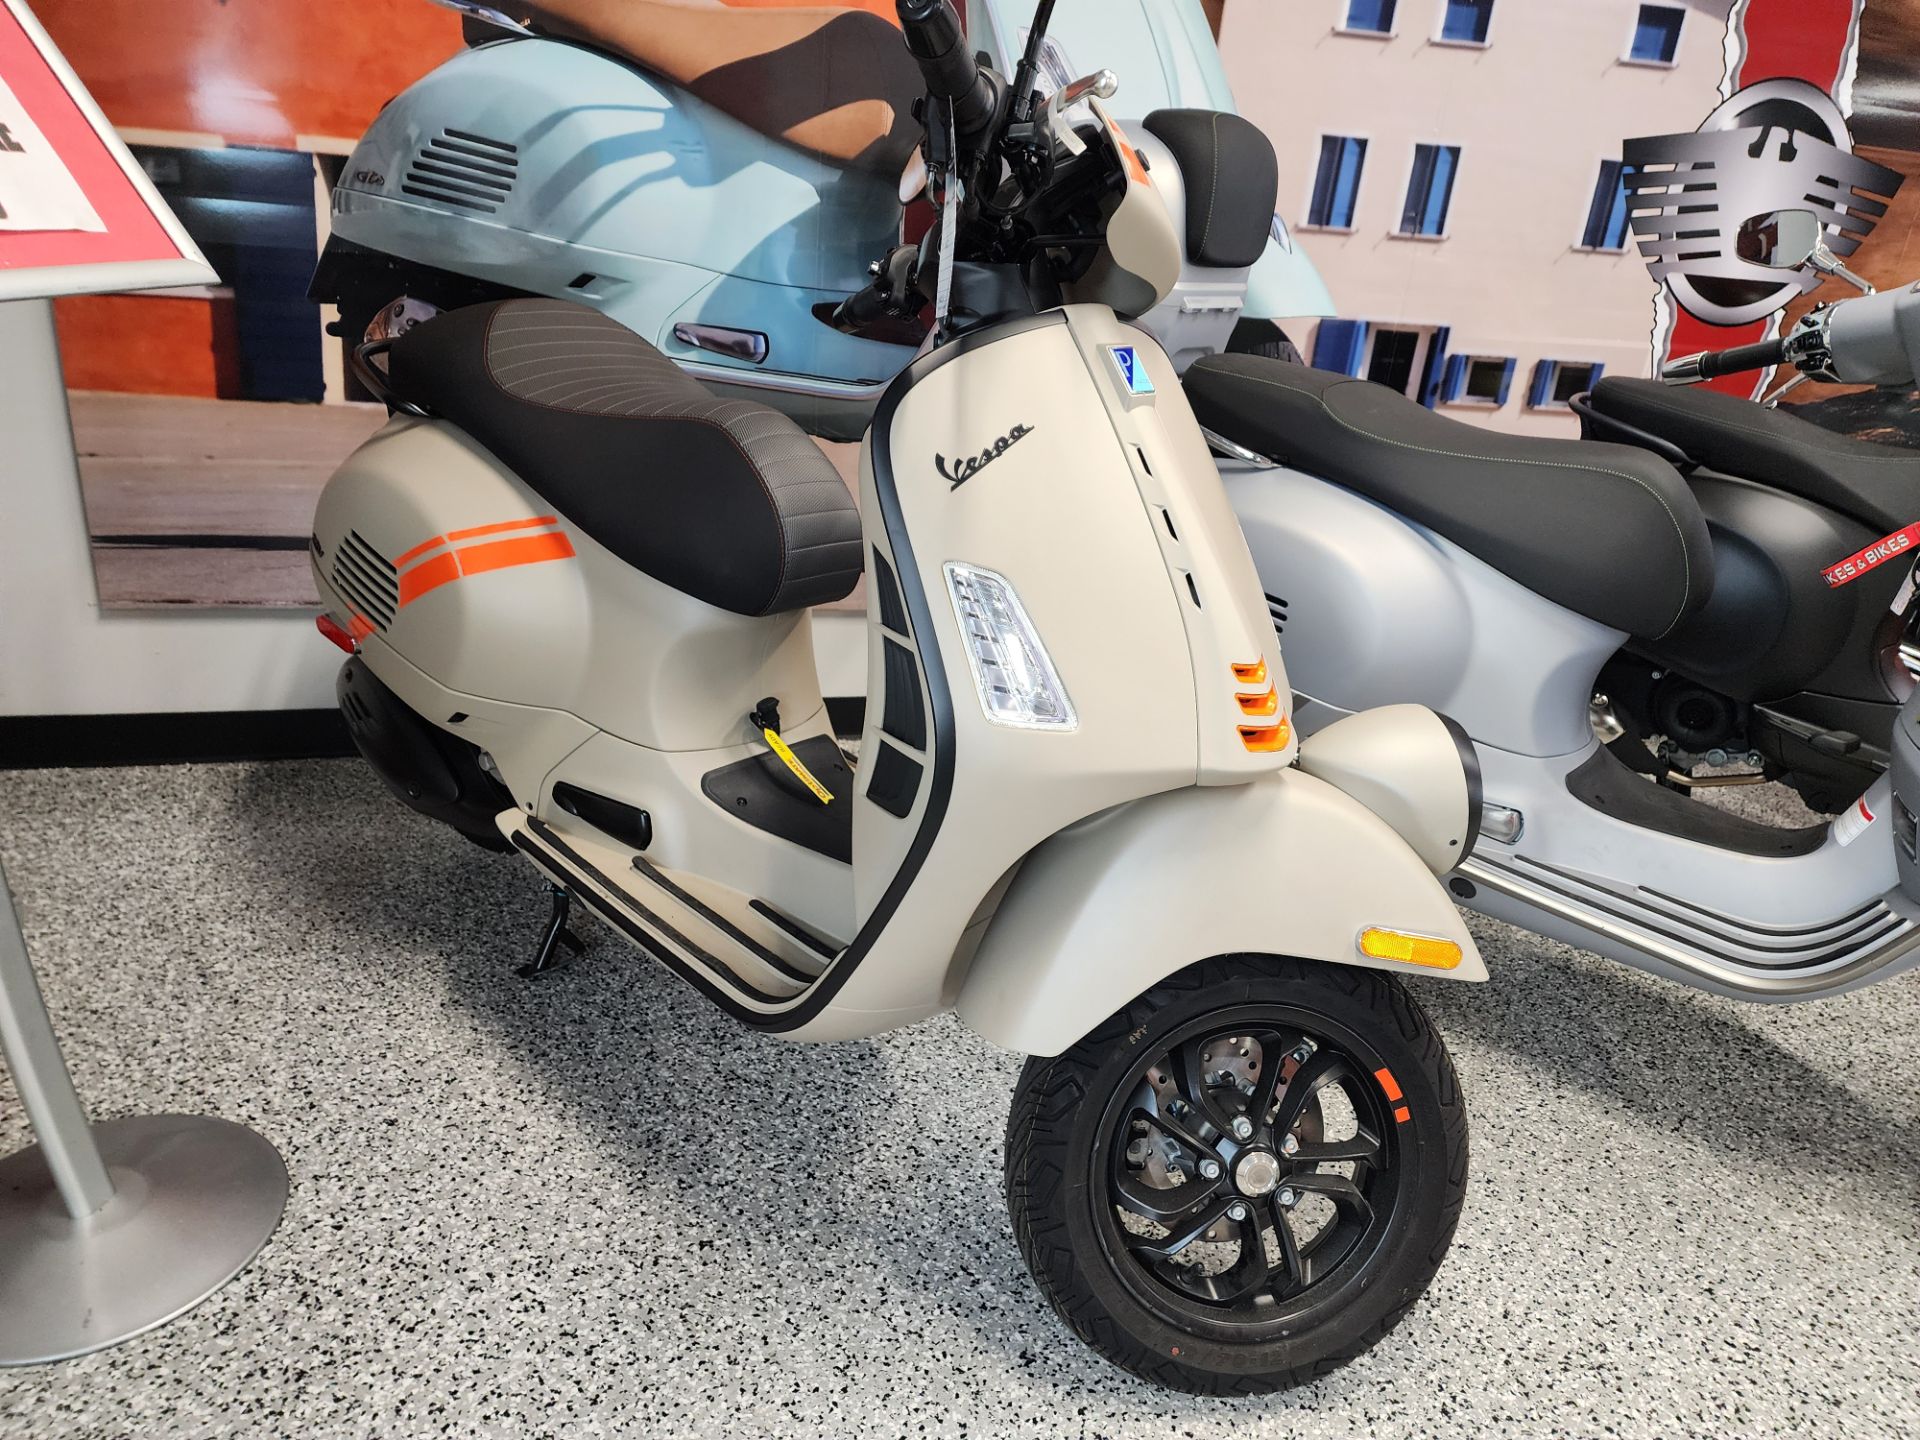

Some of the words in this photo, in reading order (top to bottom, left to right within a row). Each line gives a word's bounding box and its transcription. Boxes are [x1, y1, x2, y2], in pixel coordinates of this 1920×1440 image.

[934, 423, 1035, 493] Vespa
[1857, 559, 1867, 570] &
[1865, 534, 1909, 564] BIKES
